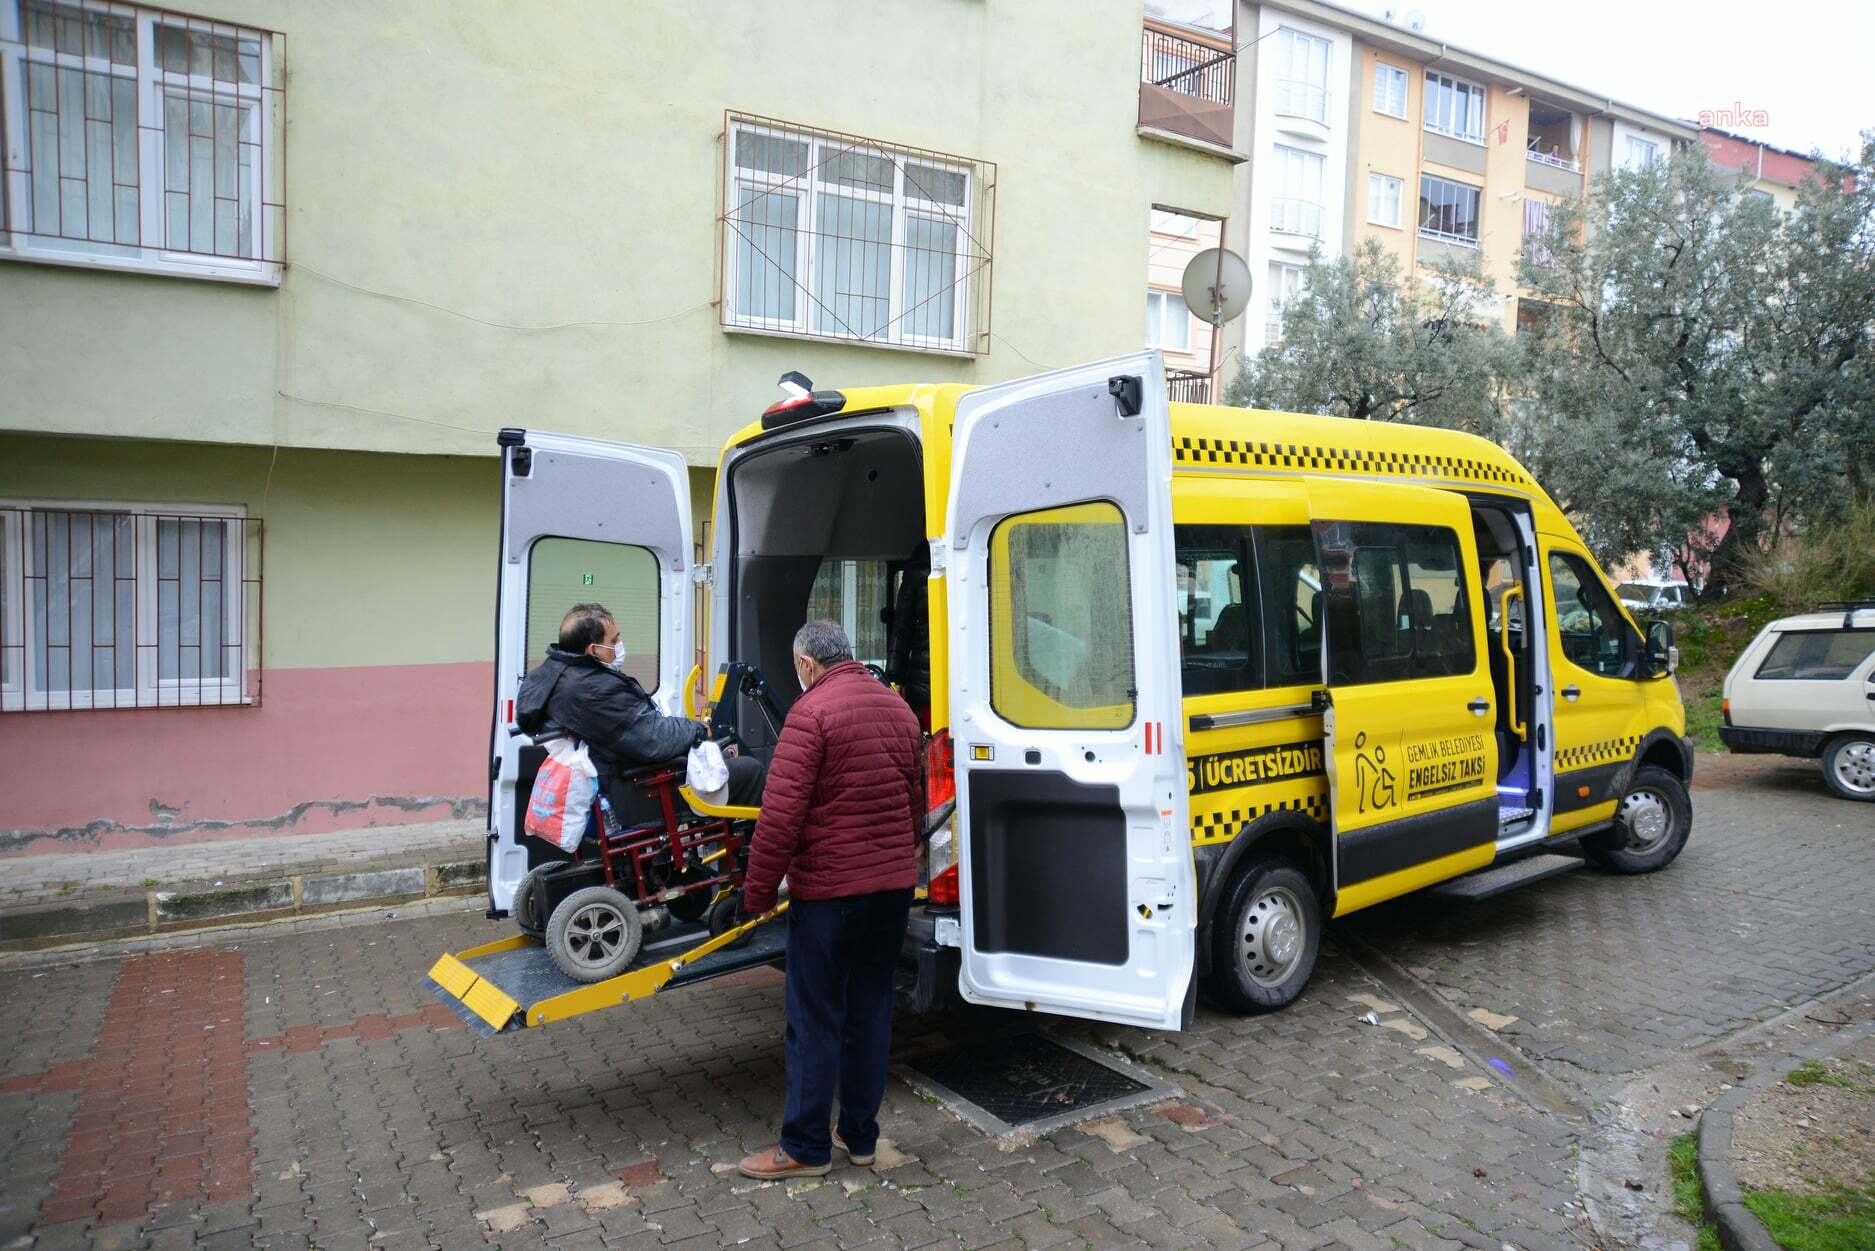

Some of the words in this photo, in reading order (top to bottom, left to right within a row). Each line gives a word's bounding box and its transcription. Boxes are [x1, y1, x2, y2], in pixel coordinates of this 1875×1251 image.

[1206, 744, 1321, 787] ÜCRETSİZDİR
[1407, 741, 1439, 763] GEMLİK
[1440, 735, 1485, 757] BELEDİYESİ
[1409, 761, 1457, 790] ENGELSİZ
[1460, 756, 1486, 778] TAKSİ
